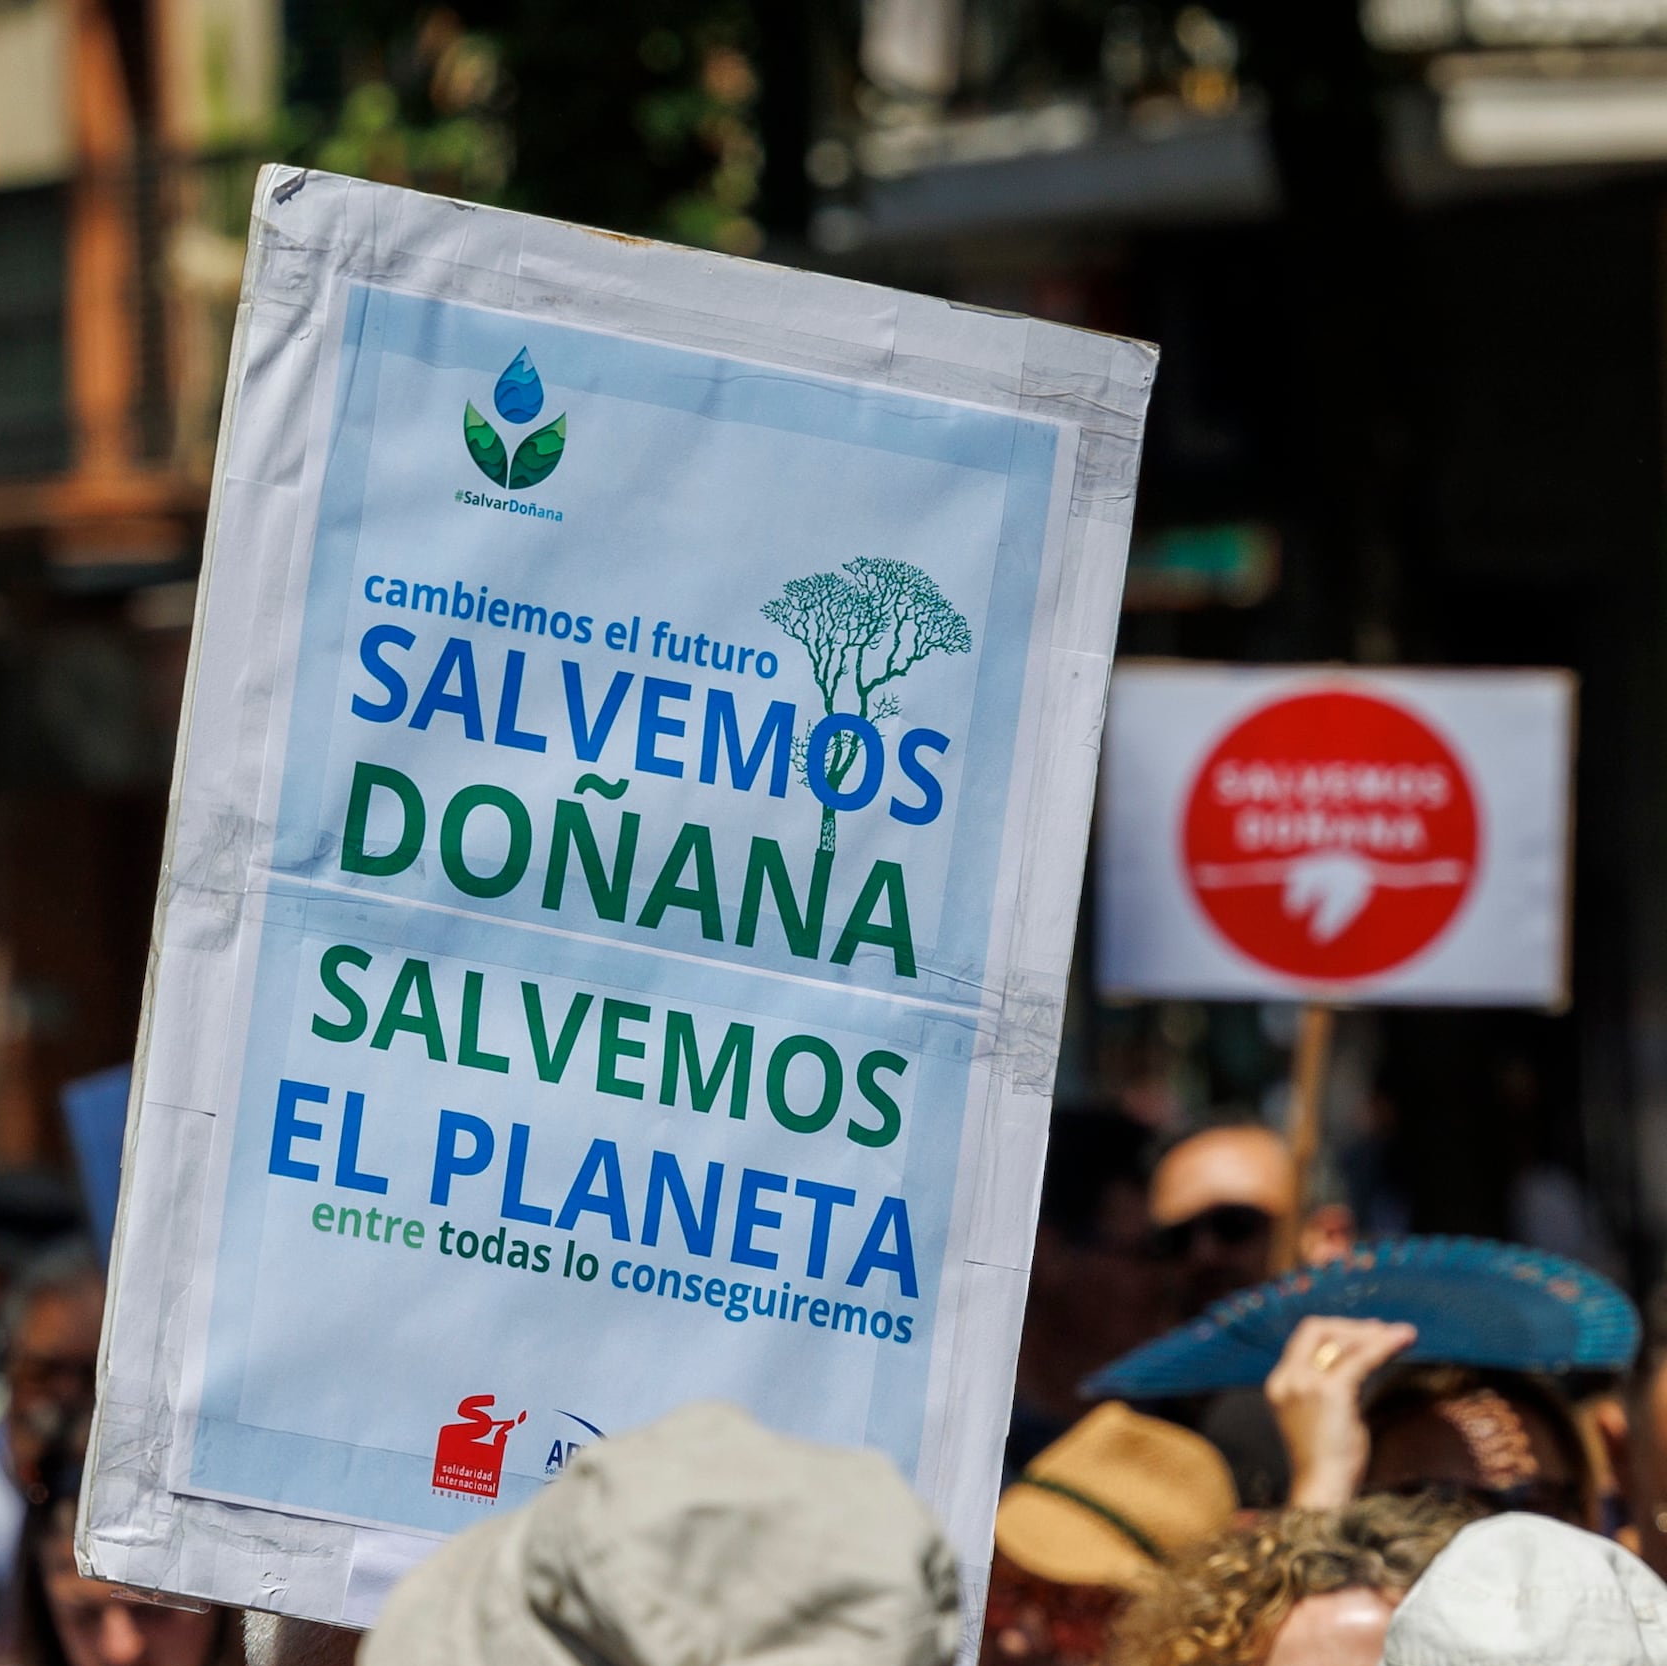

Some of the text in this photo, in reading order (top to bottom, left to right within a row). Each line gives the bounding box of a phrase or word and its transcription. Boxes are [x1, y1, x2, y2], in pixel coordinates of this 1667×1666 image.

[454, 489, 563, 522] #SalvarDoñana
[364, 575, 778, 679] cambiemos el futuro
[352, 624, 950, 825] SALVEMOS
[340, 761, 916, 979] DOÑANA
[311, 944, 908, 1148] SALVEMOS
[268, 1079, 919, 1299] EL PLANETA
[313, 1204, 915, 1344] entre todas lo conseguiremos
[435, 1474, 496, 1494] internacional
[442, 1464, 493, 1481] solidaridad
[546, 1439, 588, 1468] AP
